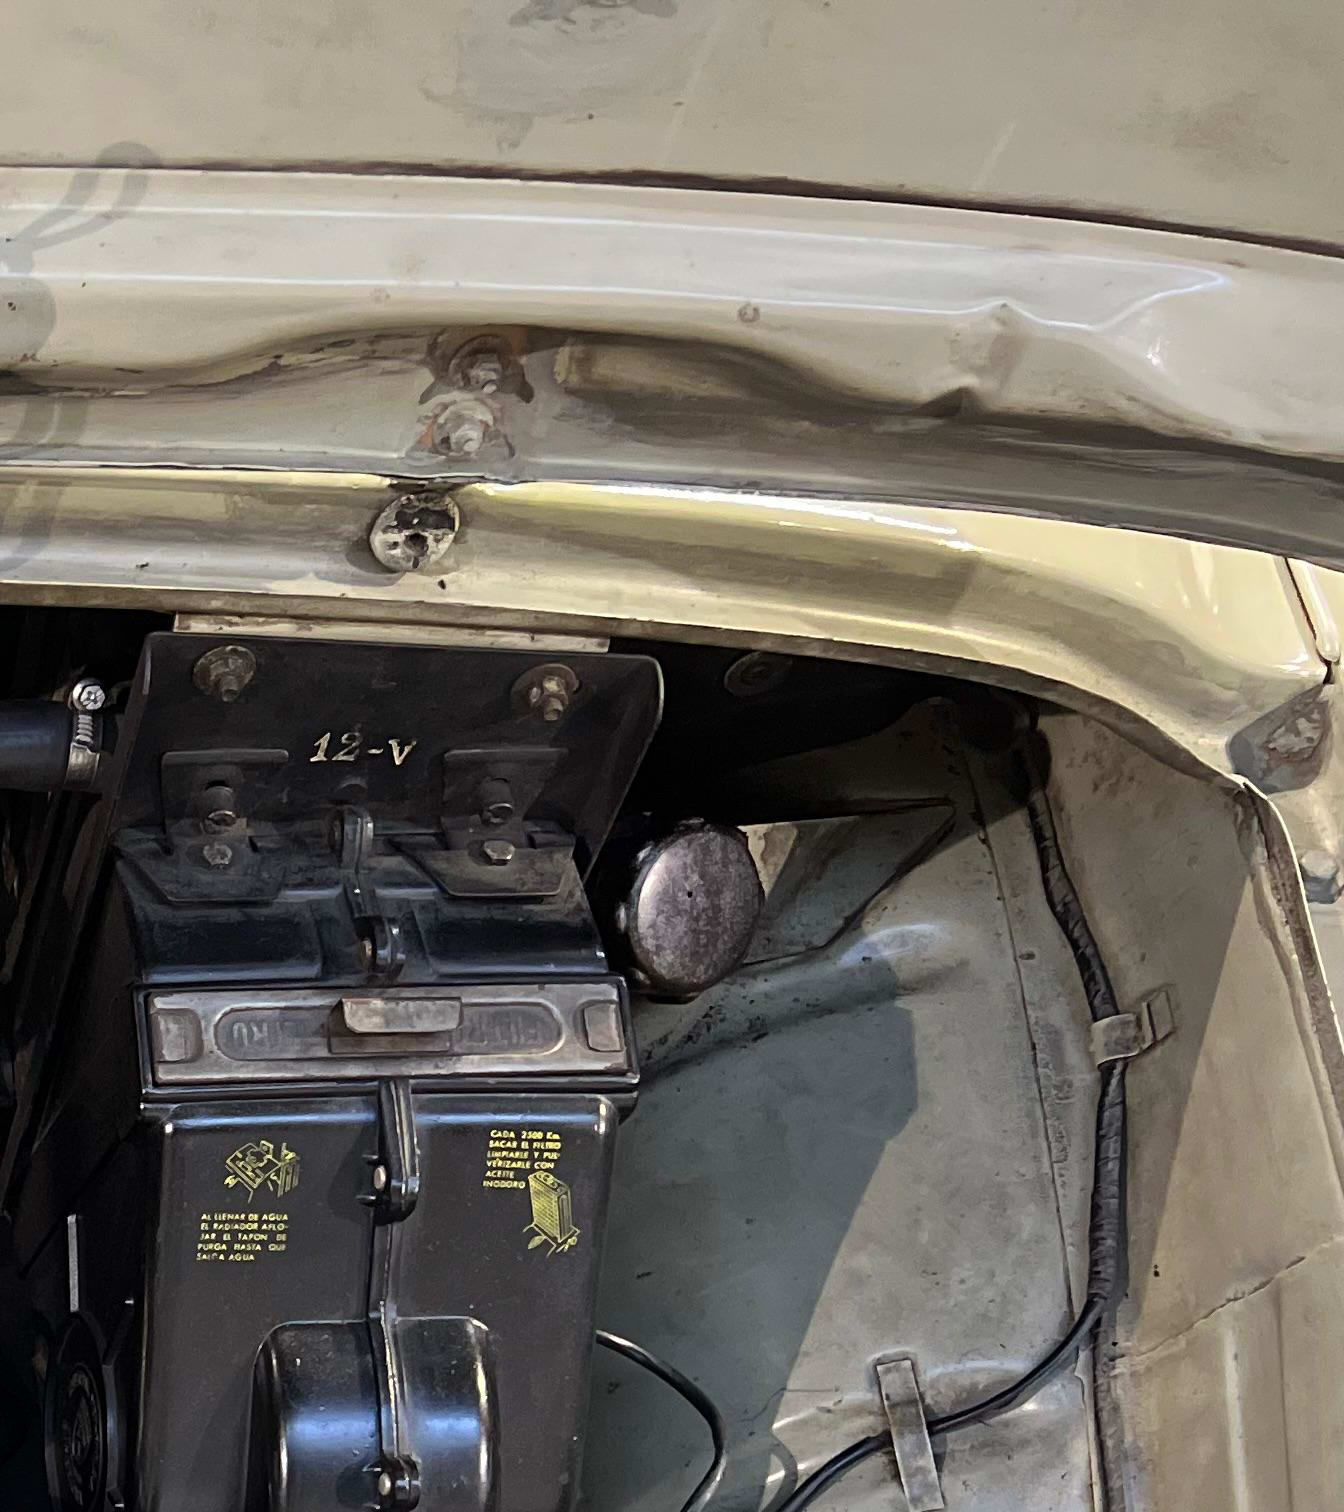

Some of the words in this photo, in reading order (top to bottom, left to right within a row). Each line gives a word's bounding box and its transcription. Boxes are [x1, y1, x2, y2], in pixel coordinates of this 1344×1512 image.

[490, 1129, 515, 1138] CADA
[489, 1139, 517, 1149] SACAR
[533, 1141, 561, 1149] FILTRO
[534, 1161, 555, 1170] CON
[485, 1170, 515, 1179] ACEITE
[483, 1180, 526, 1189] INODORO
[248, 1213, 259, 1221] DE
[261, 1213, 289, 1221] AGUA
[213, 1222, 259, 1231] RADIADOR
[276, 1233, 287, 1241] DE
[197, 1243, 227, 1251] PURGA
[234, 1243, 262, 1251] HASTA
[228, 1253, 255, 1261] AGUA
